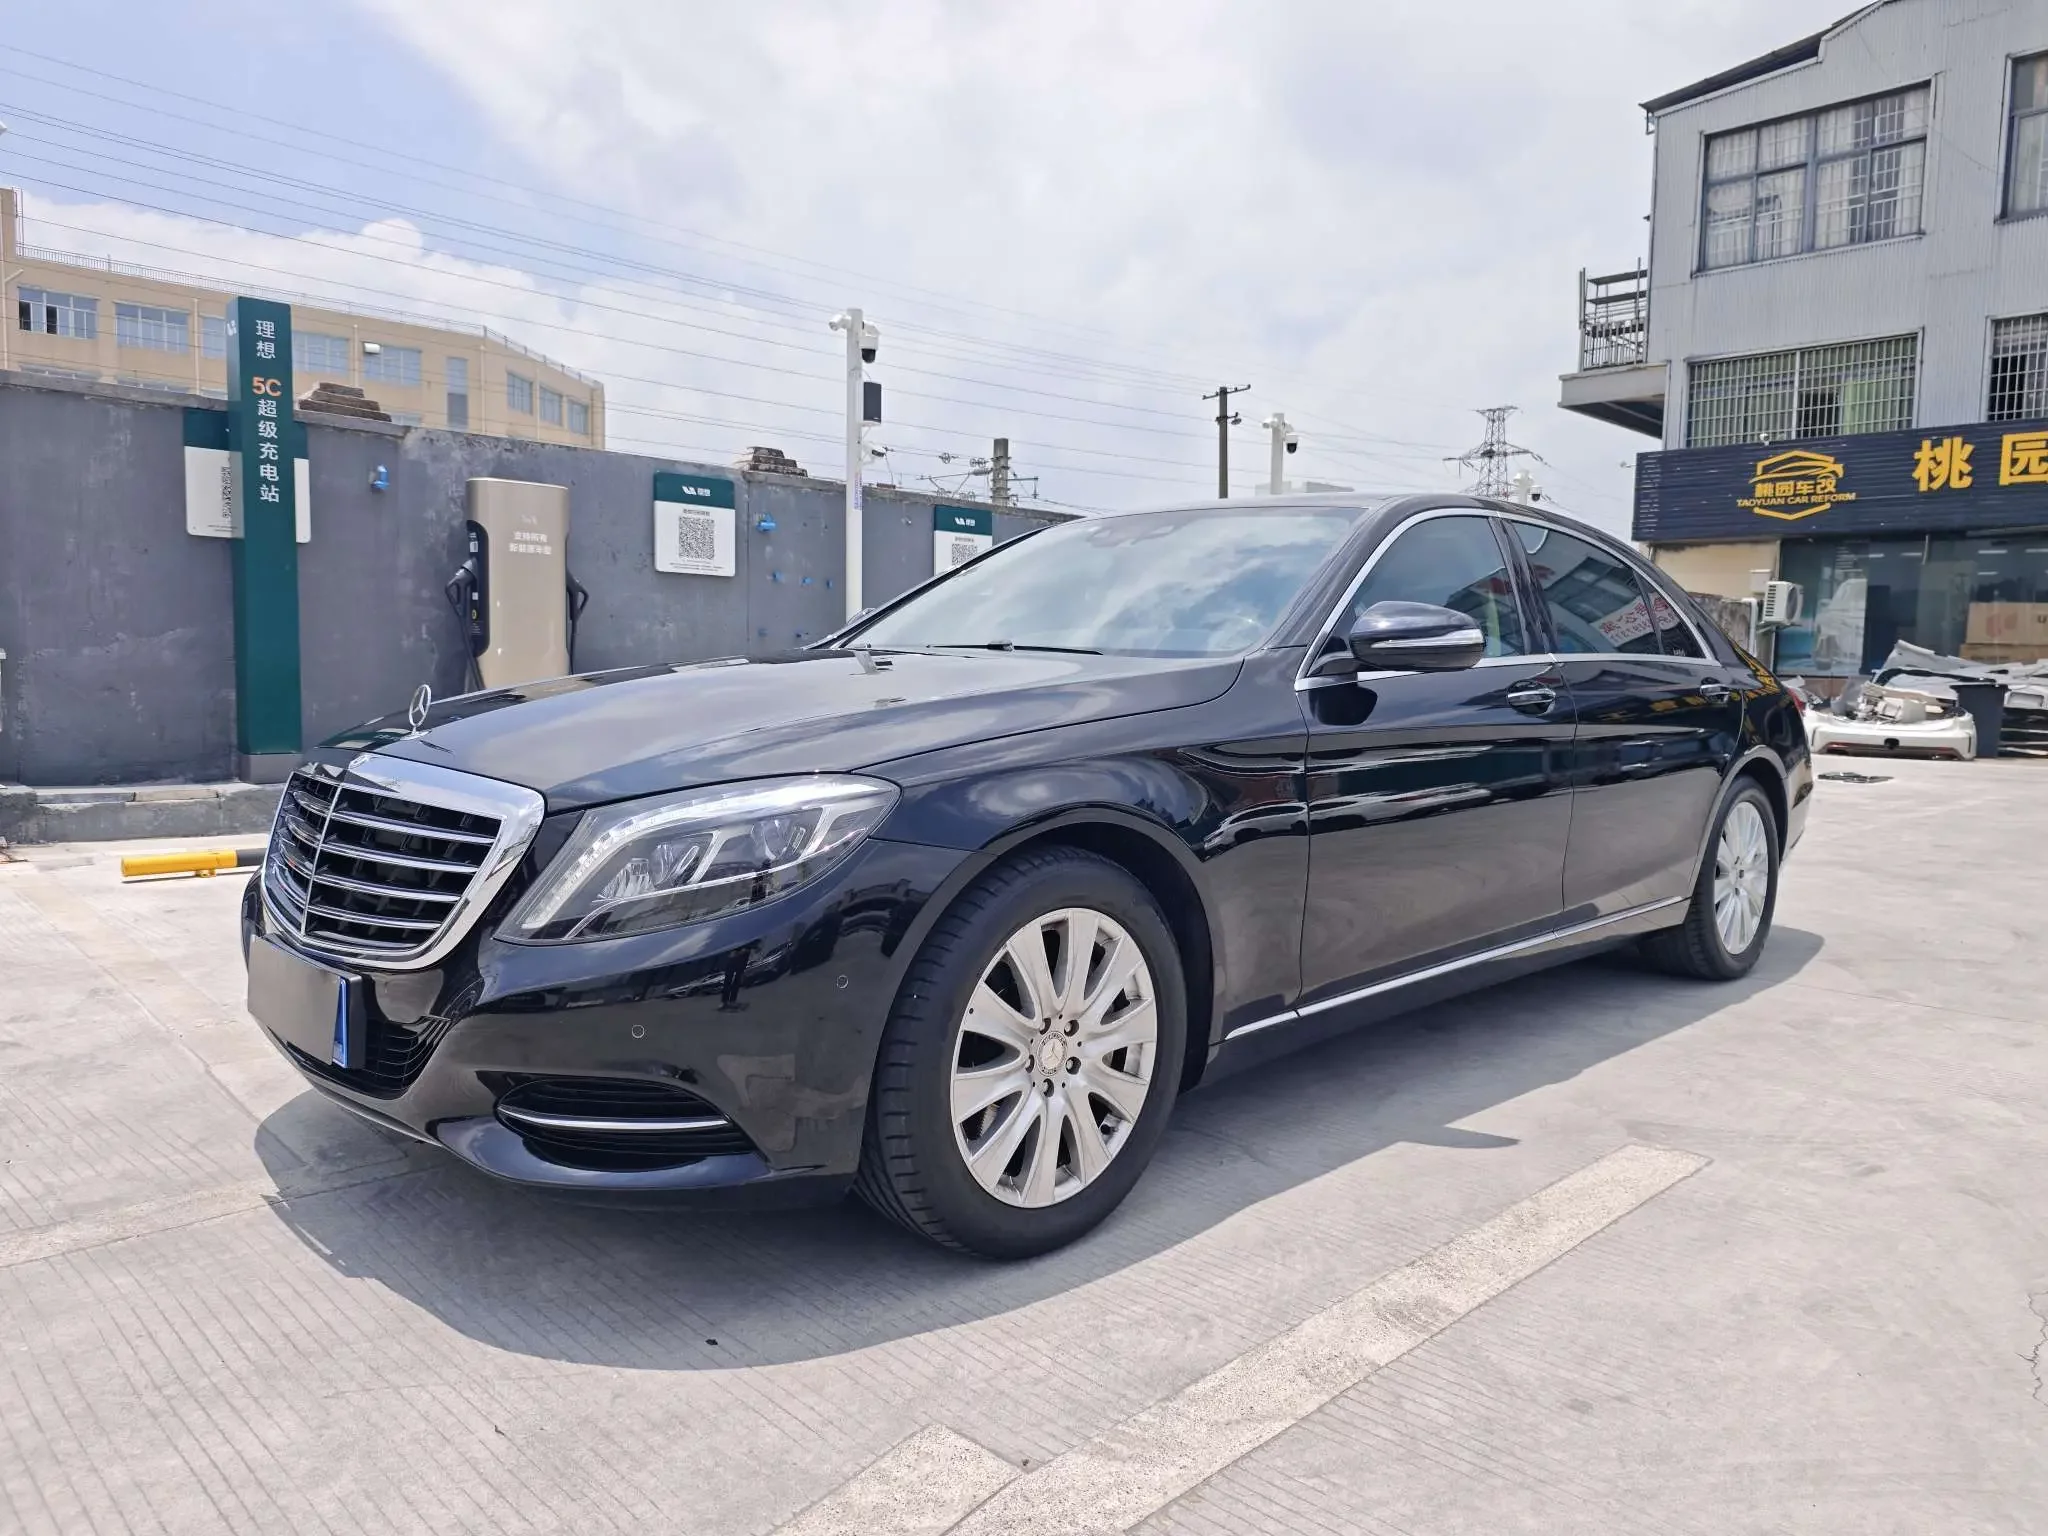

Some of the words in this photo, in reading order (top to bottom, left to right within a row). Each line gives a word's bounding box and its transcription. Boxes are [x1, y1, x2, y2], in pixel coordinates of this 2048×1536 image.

[255, 319, 276, 359] 理想
[252, 376, 282, 397] 5C
[257, 399, 280, 503] 超级充电站
[1911, 432, 2048, 492] 桃园
[1737, 496, 1785, 507] TAOYUAN
[1787, 495, 1809, 504] CAR
[1811, 492, 1857, 503] REFORM
